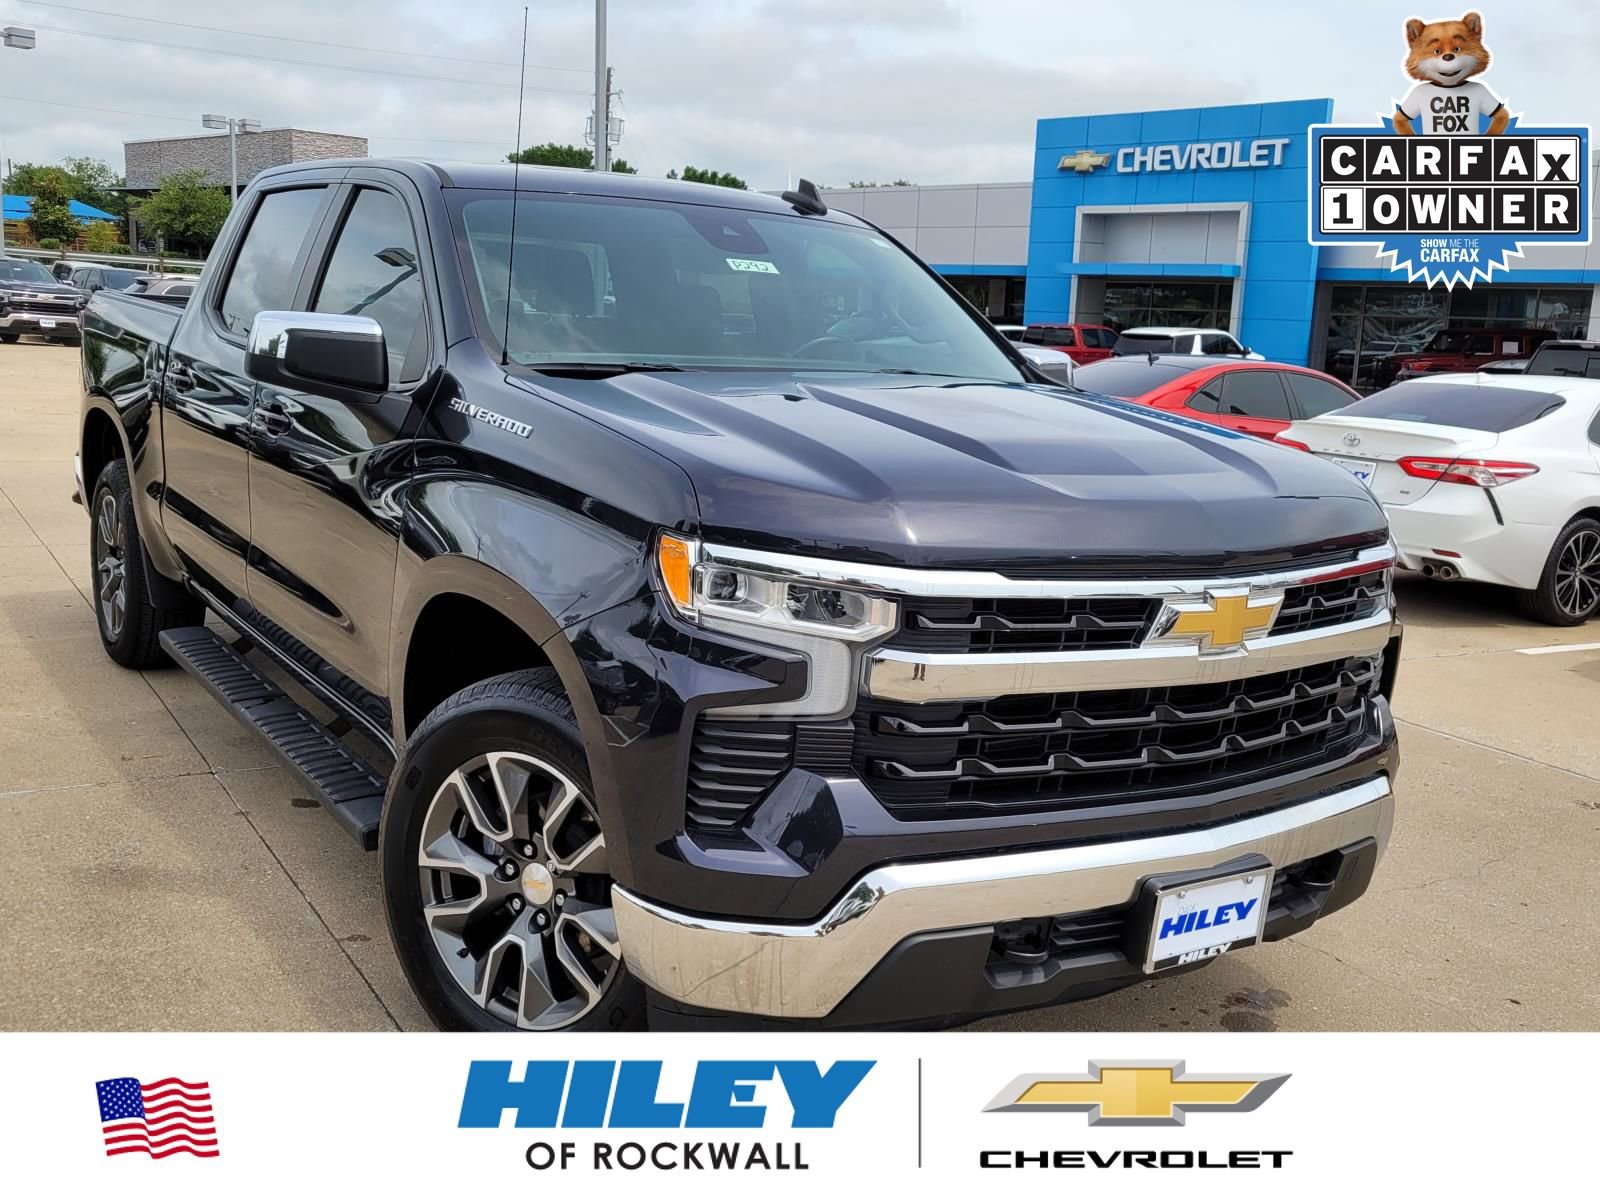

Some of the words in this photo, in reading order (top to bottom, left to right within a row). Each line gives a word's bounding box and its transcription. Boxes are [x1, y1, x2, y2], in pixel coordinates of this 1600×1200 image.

[1116, 138, 1291, 173] CHEVROLET
[448, 397, 533, 437] SILVERADO
[1159, 898, 1258, 940] HILEY
[1177, 942, 1233, 965] HILEY
